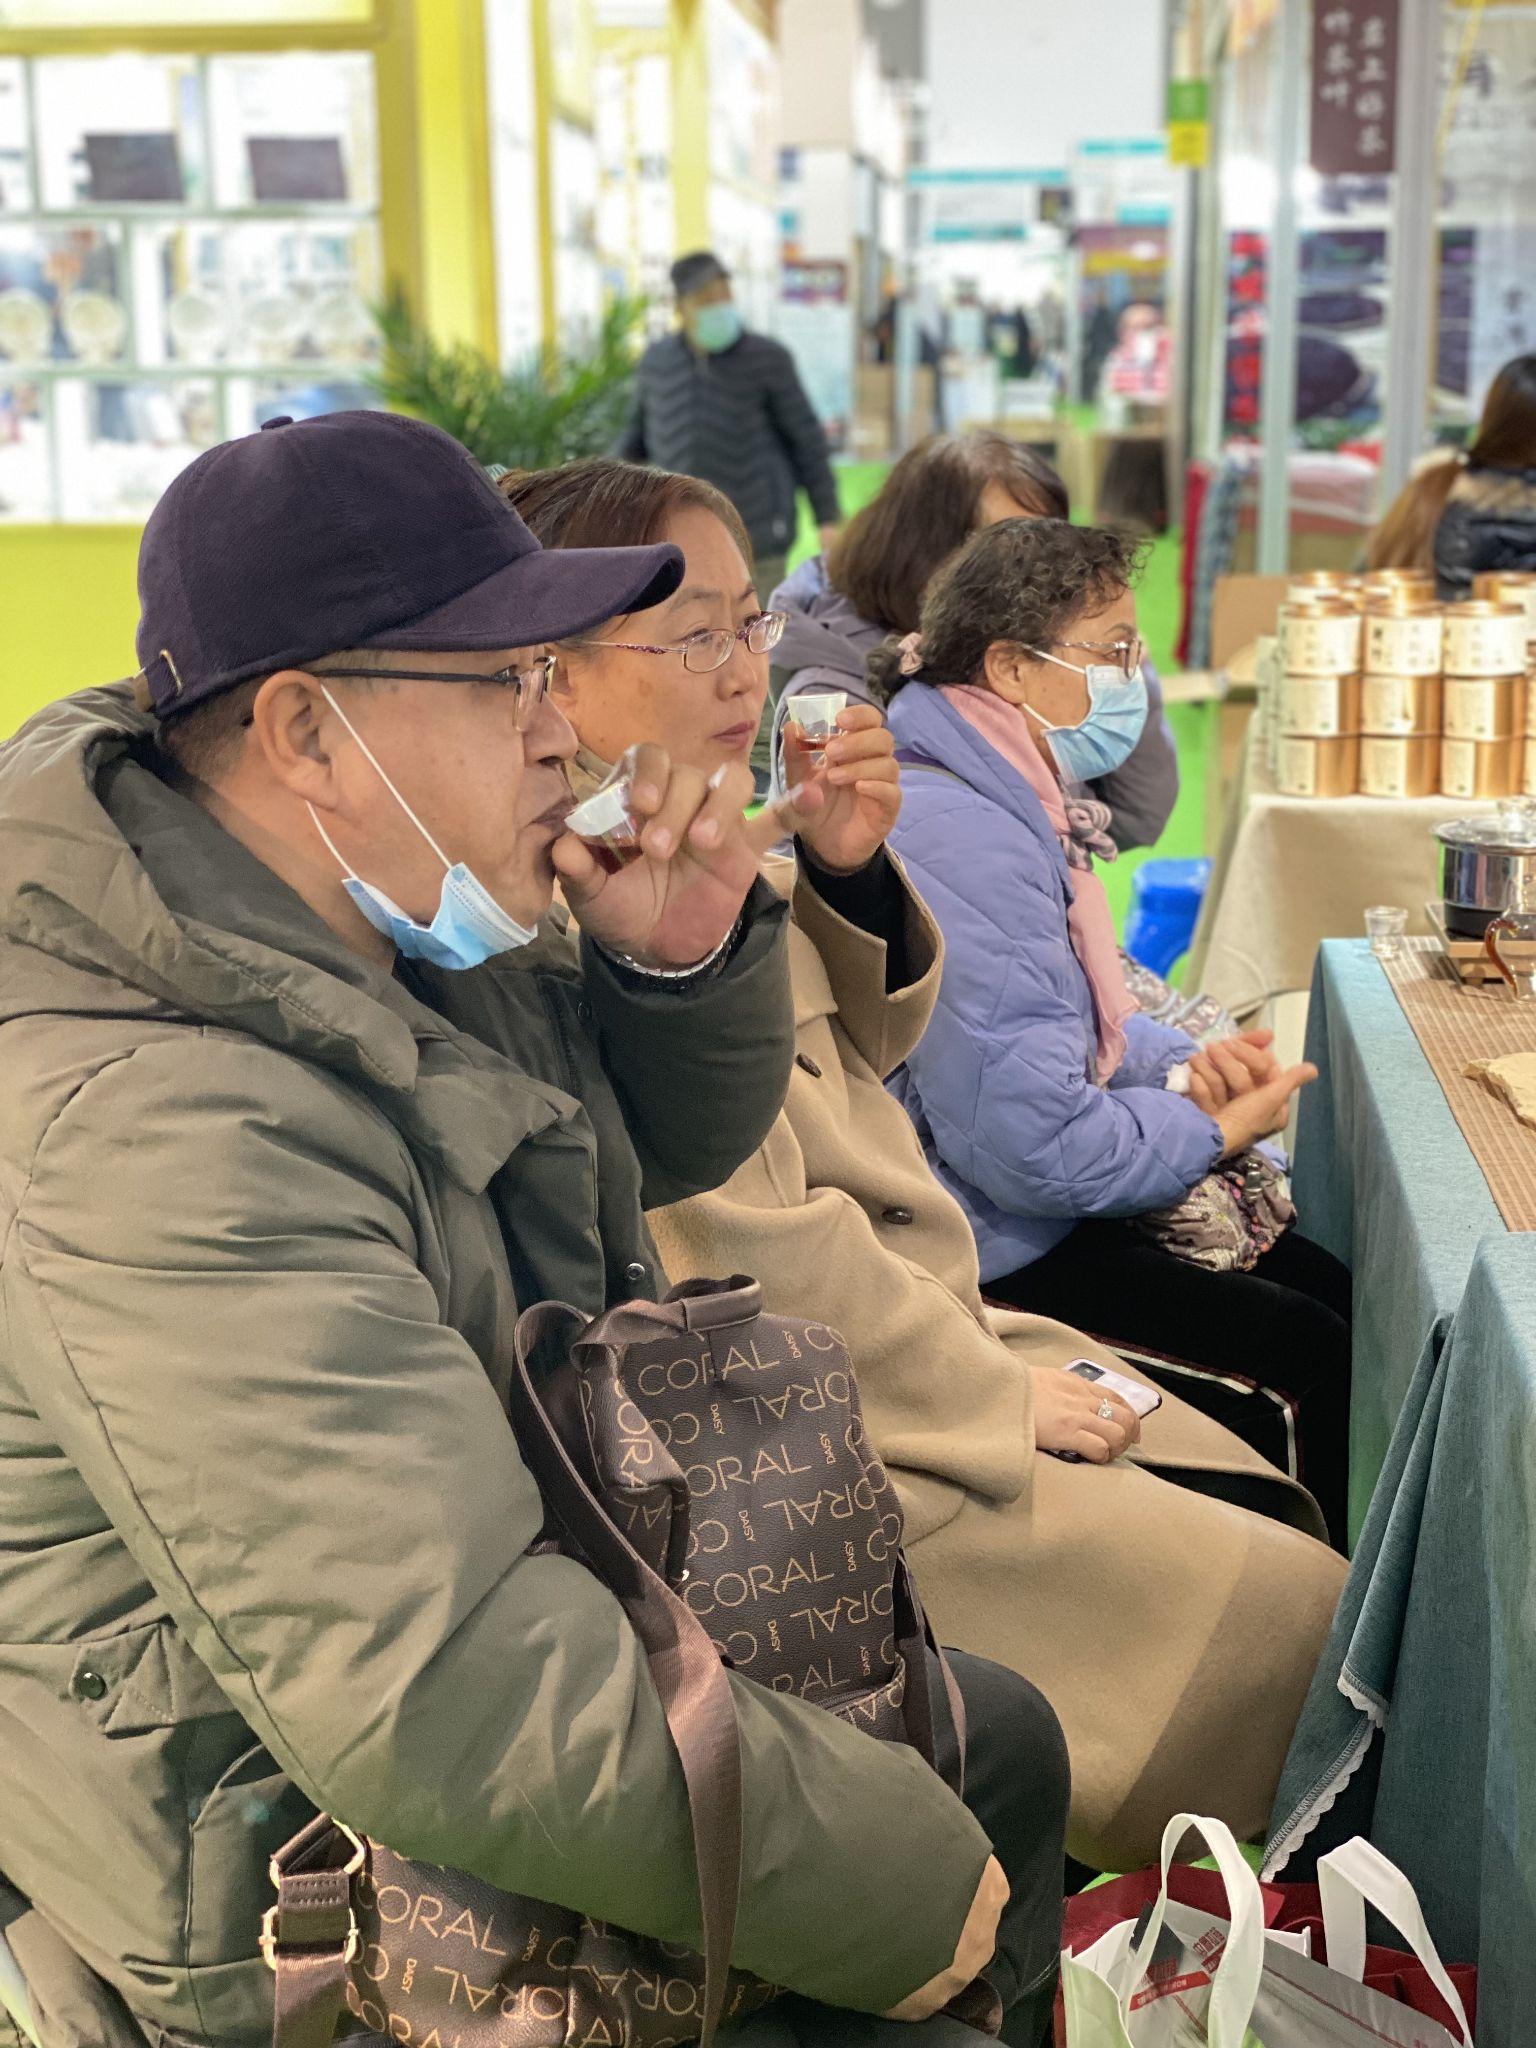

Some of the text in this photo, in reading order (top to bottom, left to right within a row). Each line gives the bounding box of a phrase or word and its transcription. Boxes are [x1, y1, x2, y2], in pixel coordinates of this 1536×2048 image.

[781, 1330, 802, 1359] DAISY
[732, 1371, 850, 1425] ORAL
[709, 1403, 726, 1435] DAISY
[817, 1432, 836, 1465] DAISY
[685, 1443, 812, 1498] ORAL
[738, 1509, 757, 1542] DAISY
[843, 1540, 857, 1572] DAISY
[683, 1551, 835, 1615] CORAL
[789, 1582, 894, 1640] ORAL
[767, 1619, 782, 1652] DAISY
[772, 1656, 852, 1700] RAL
[859, 1645, 871, 1677] DAISY
[400, 1957, 418, 1994] DAISY
[433, 1964, 567, 2021] ORAL
[571, 1965, 706, 2018] ORAL
